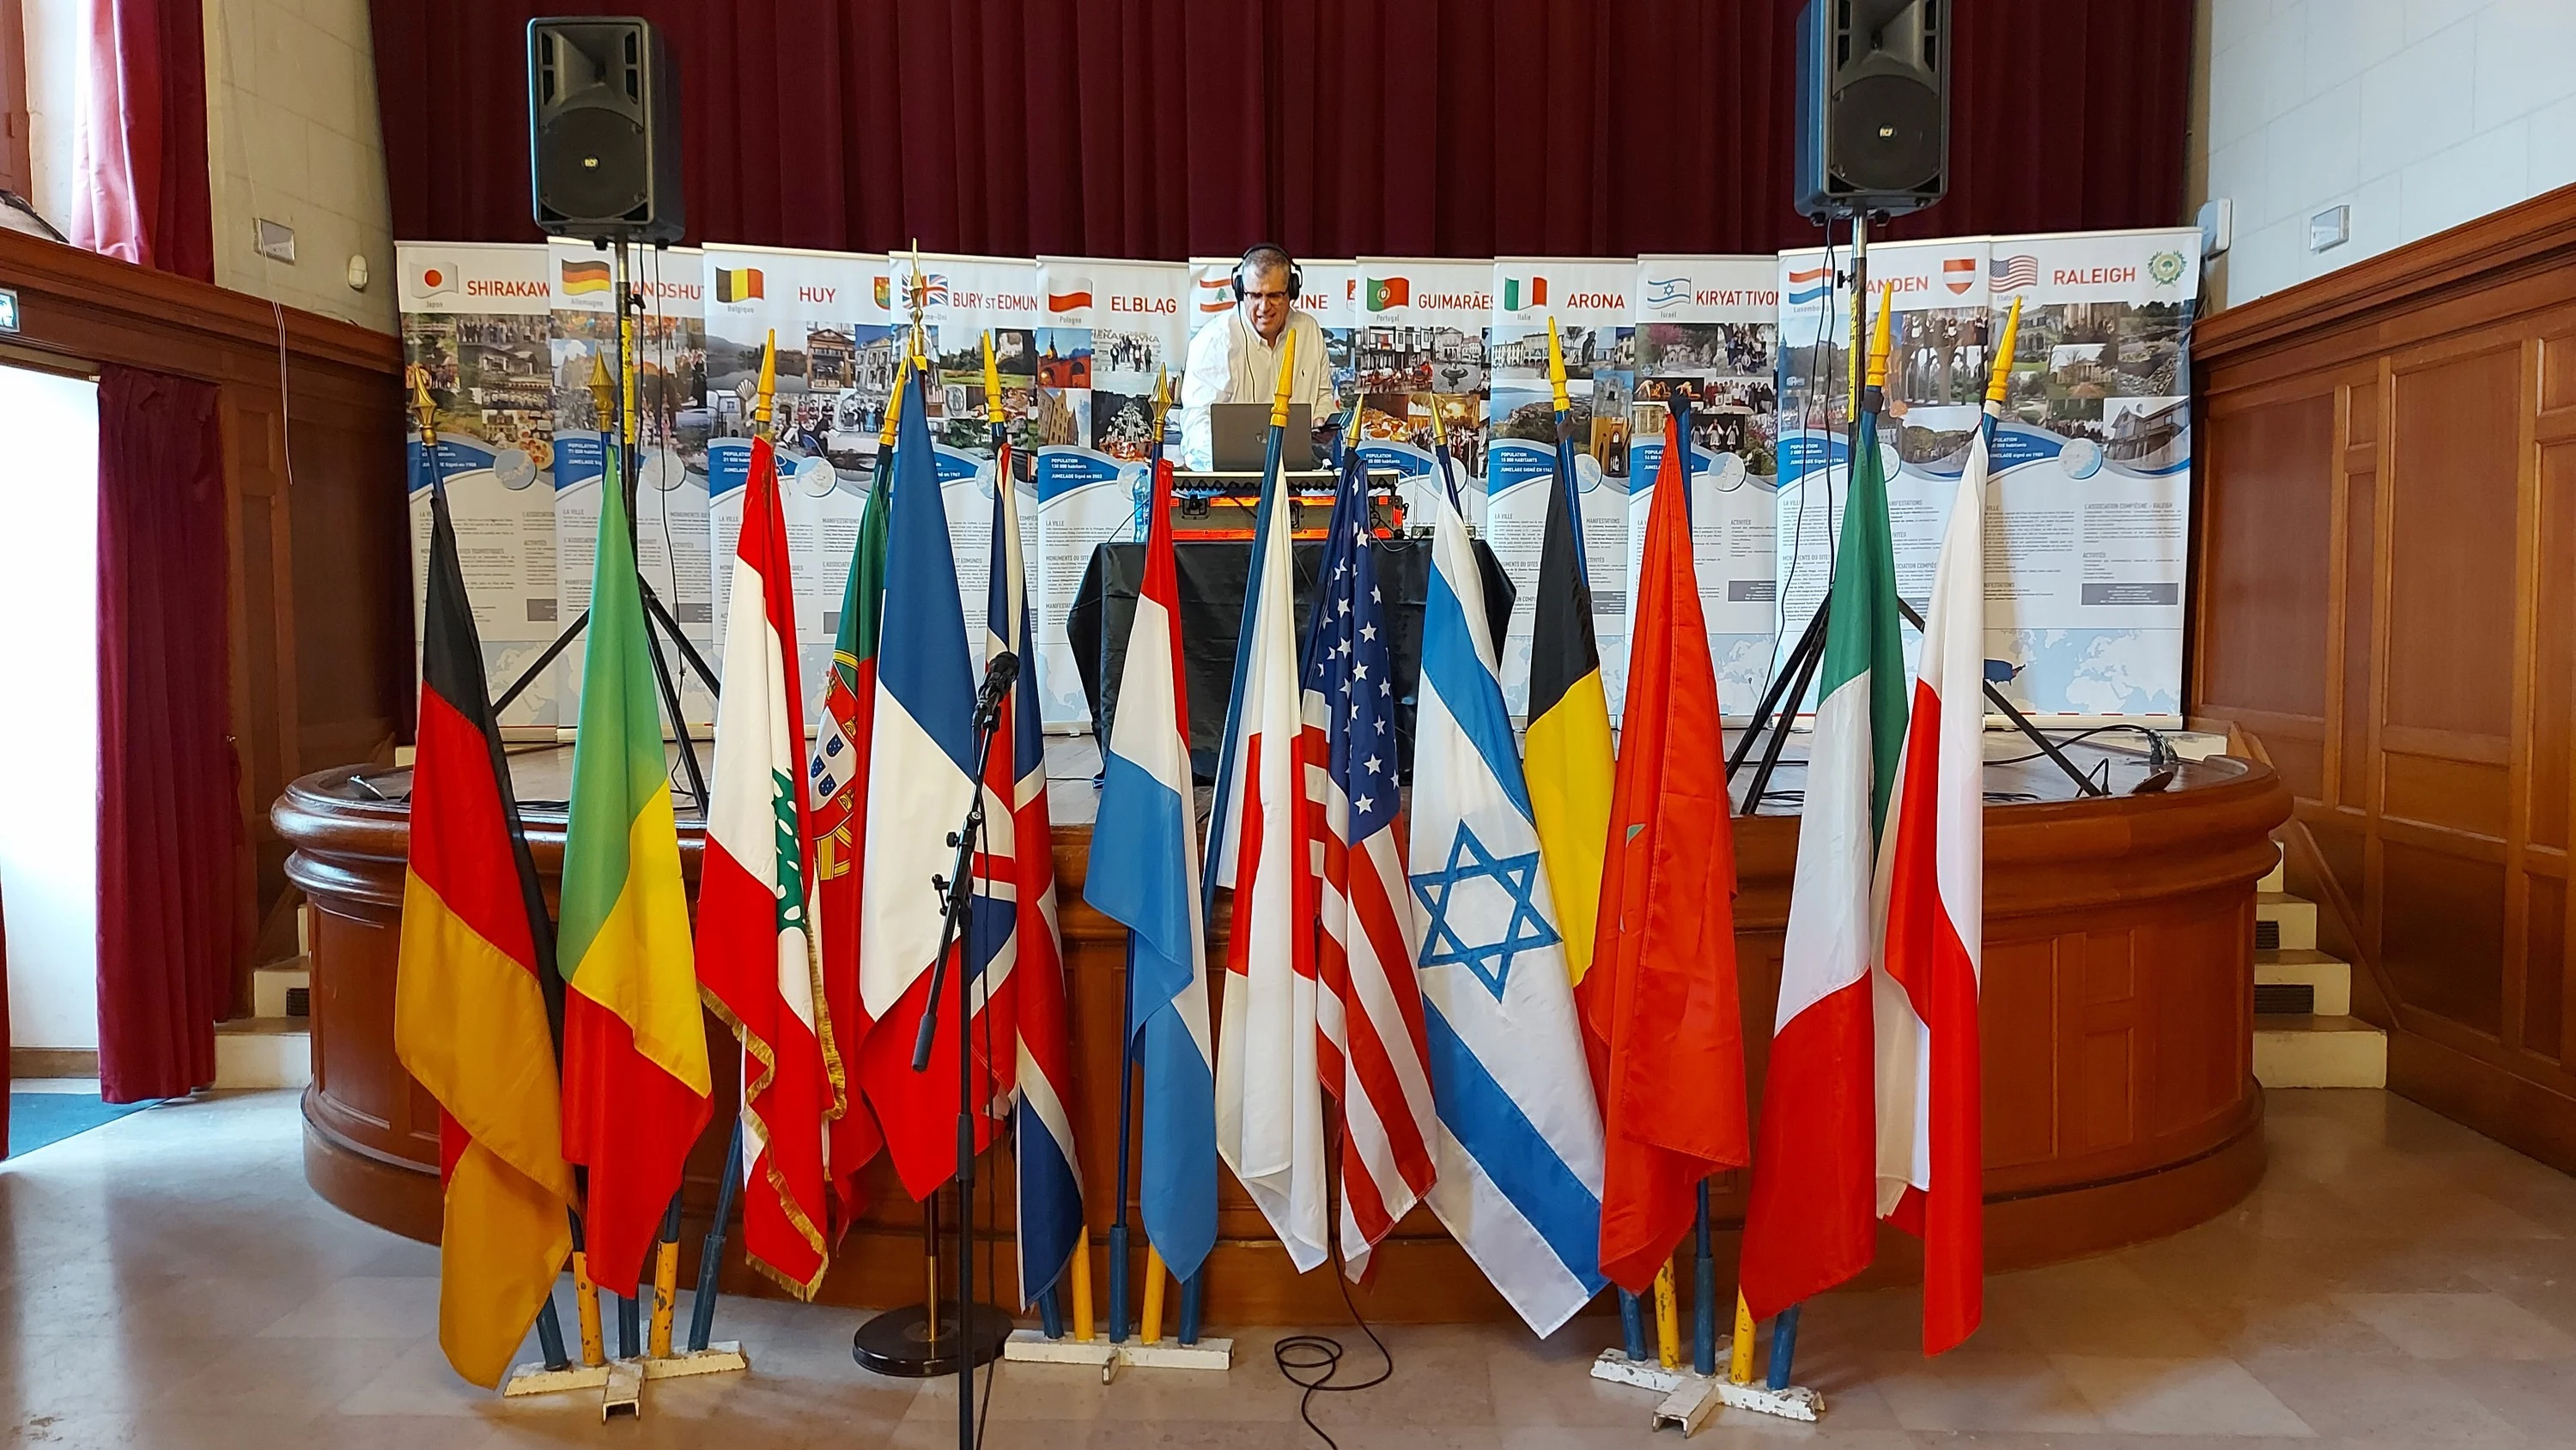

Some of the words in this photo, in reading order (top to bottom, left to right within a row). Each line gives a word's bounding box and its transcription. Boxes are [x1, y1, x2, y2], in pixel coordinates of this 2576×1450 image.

[1866, 276, 1929, 294] ANDEN
[2053, 267, 2136, 285] RALEIGH
[467, 280, 550, 298] SHIRAKAW
[631, 281, 705, 300] ANDSHU
[799, 286, 836, 304] HUY
[1696, 290, 1742, 306] KIRYAT
[952, 292, 983, 310] BURY
[985, 298, 996, 310] ST
[997, 294, 1038, 312] EDMUN
[1110, 296, 1177, 316] ELBLĄG
[1419, 290, 1494, 310] GUIMARÃE
[1566, 293, 1625, 310] ARONA
